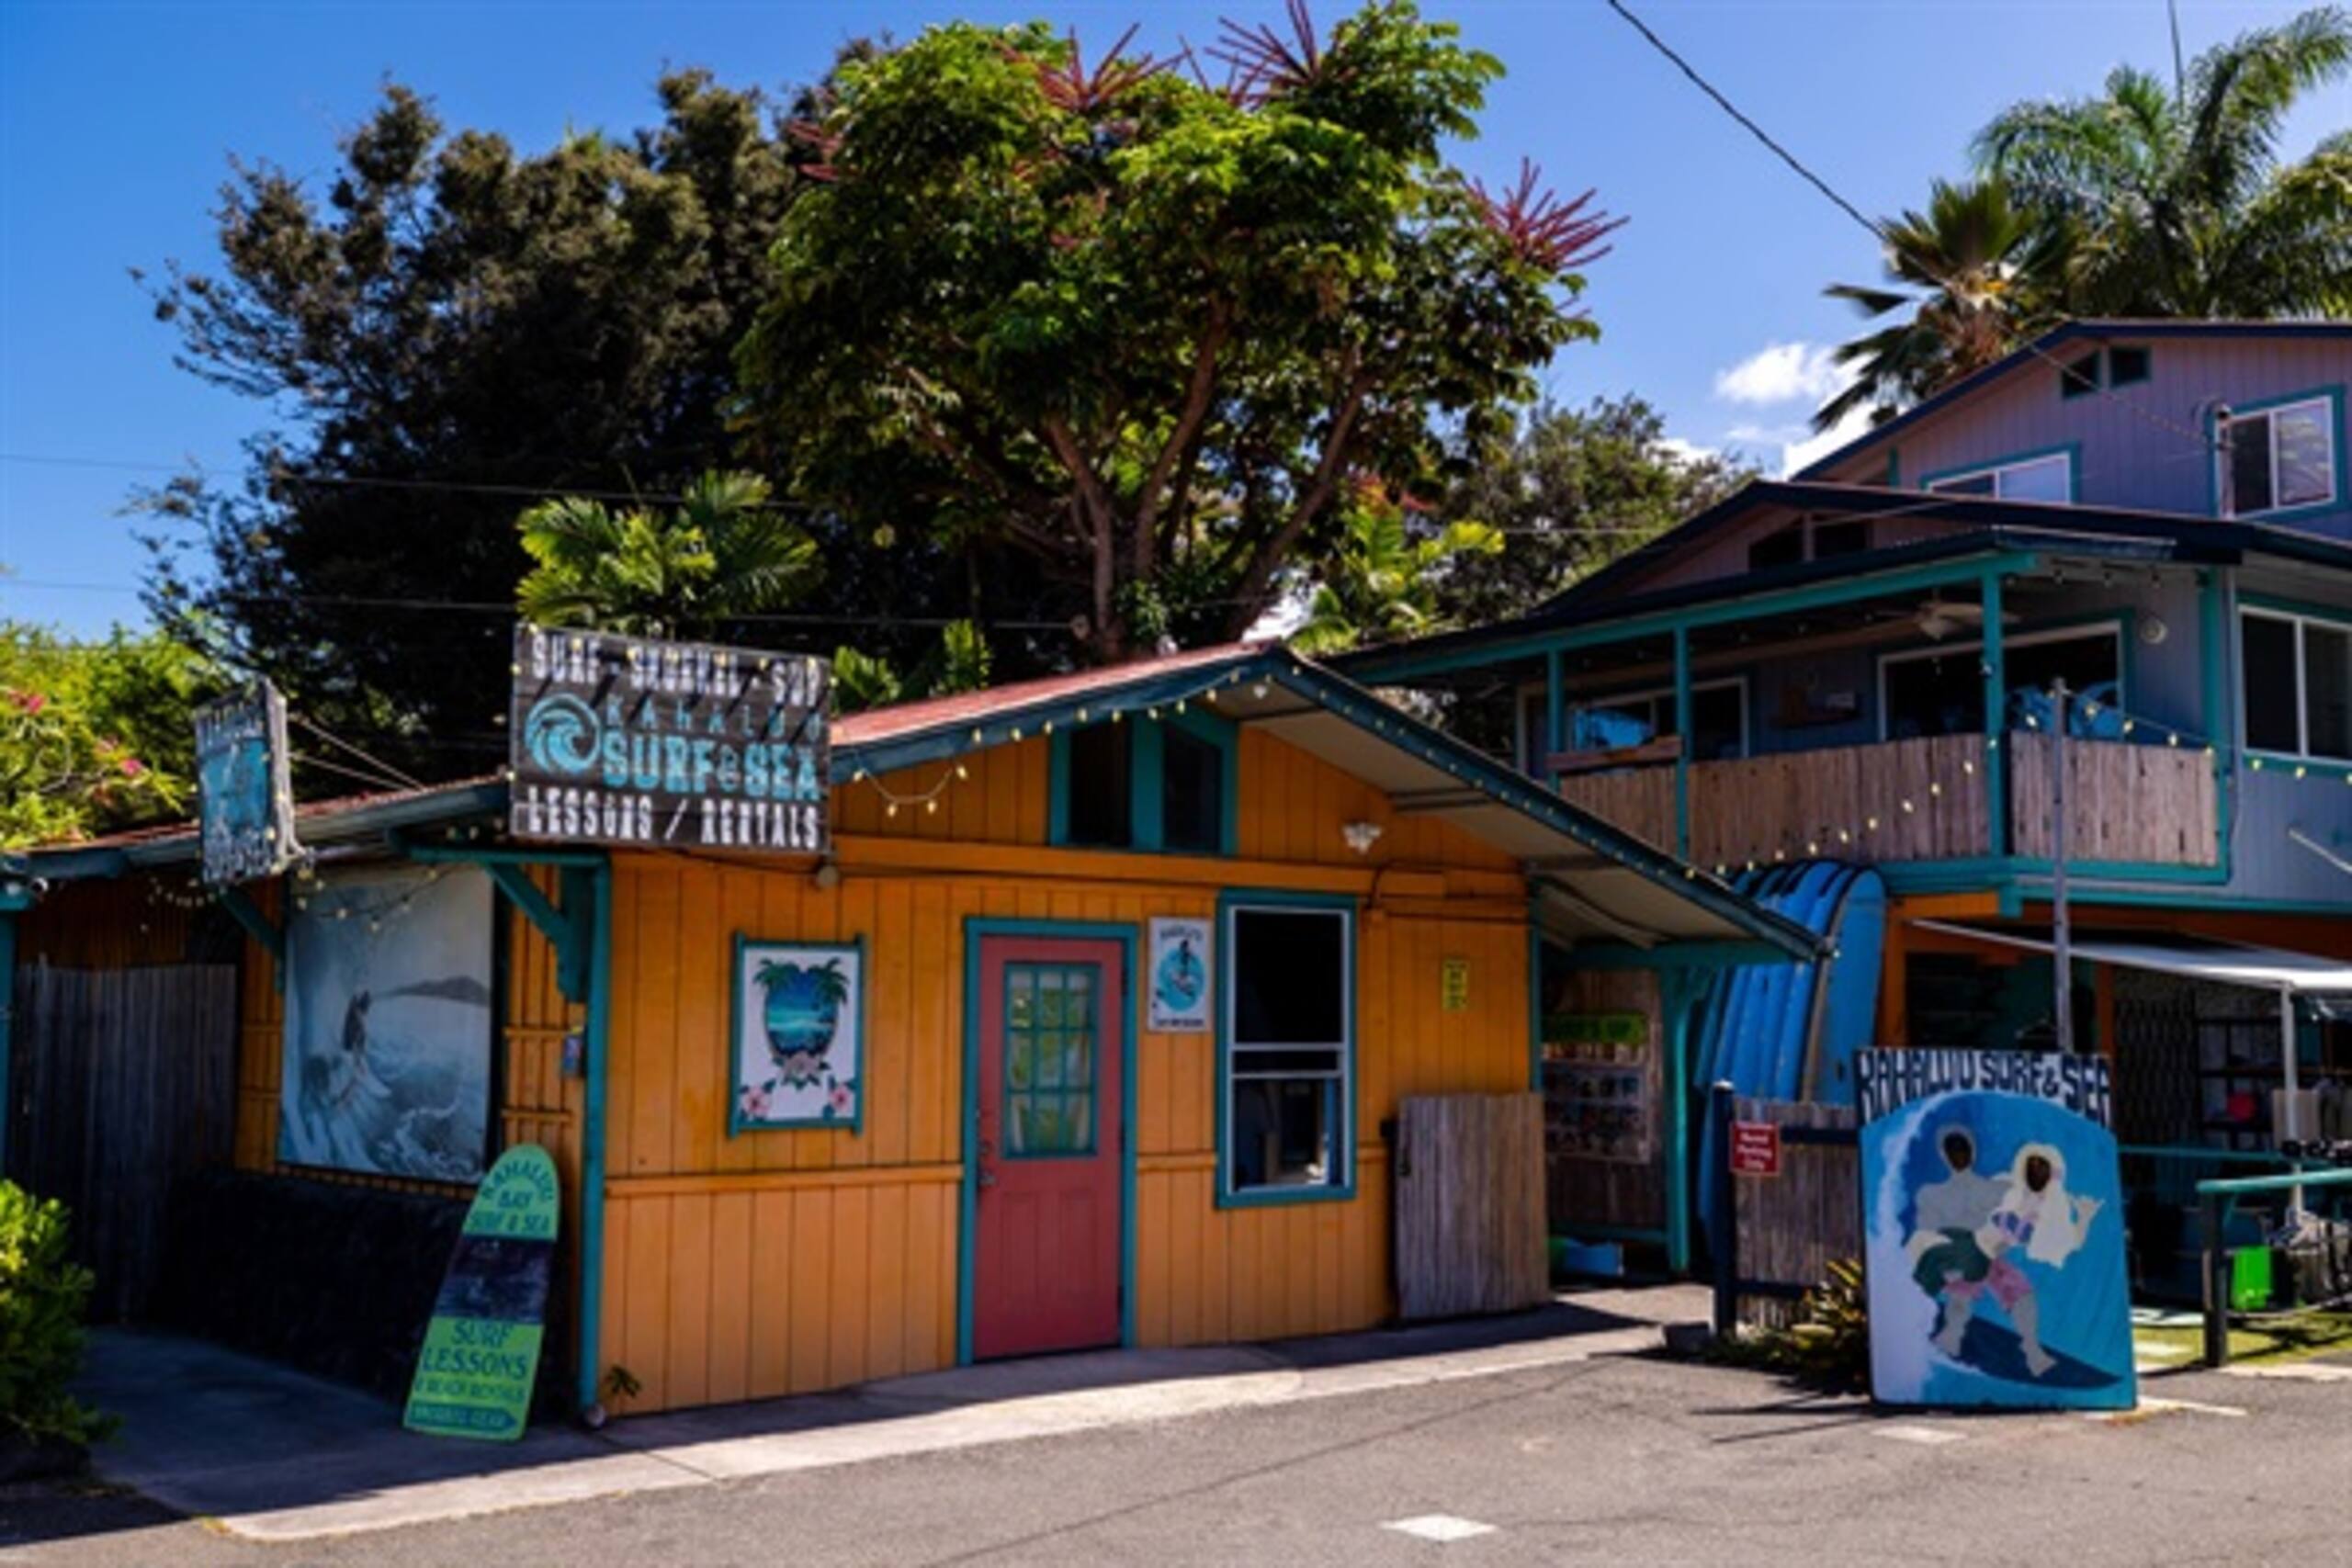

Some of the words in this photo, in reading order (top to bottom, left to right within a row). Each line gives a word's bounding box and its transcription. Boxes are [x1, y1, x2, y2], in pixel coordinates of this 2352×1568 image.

[602, 729, 716, 794] SURF
[743, 739, 821, 801] SEA
[527, 785, 653, 841] LESSONS
[700, 798, 819, 850] RENTALS
[451, 1317, 515, 1348] SURF
[423, 1346, 528, 1381] LESSONS
